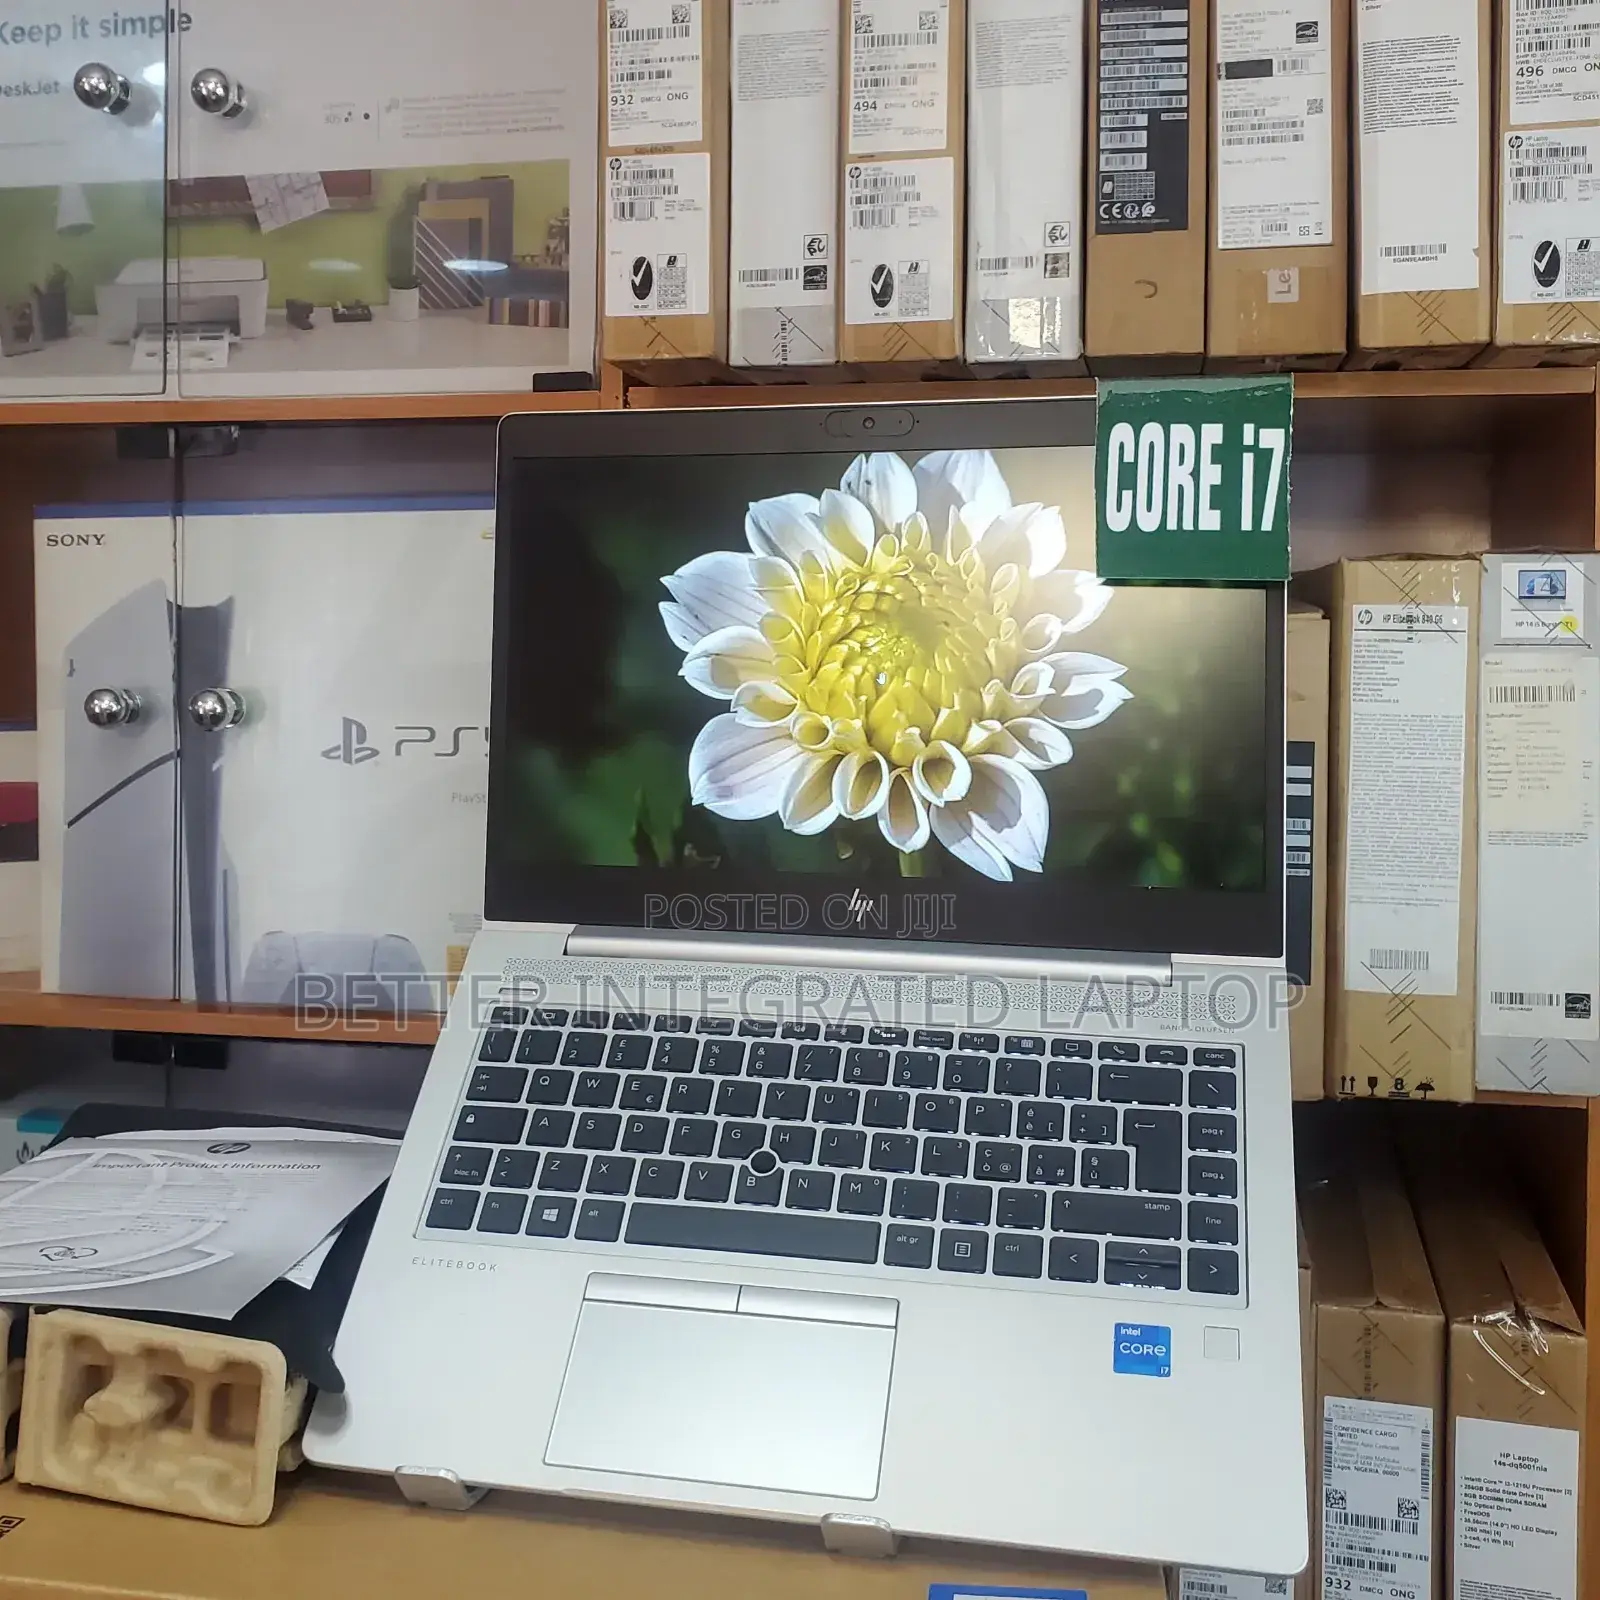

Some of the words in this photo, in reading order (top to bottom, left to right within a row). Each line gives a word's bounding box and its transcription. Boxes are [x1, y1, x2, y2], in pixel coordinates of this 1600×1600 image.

[72, 14, 90, 40] it
[99, 8, 193, 40] simple
[1516, 65, 1544, 78] 496
[1552, 66, 1577, 74] DMCQ
[0, 80, 60, 98] eskJet
[611, 94, 634, 106] 932
[667, 92, 689, 101] ONG
[853, 100, 878, 111] 494
[912, 99, 935, 108] ONG
[1105, 421, 1224, 532] CORE
[1240, 422, 1286, 532] i7
[46, 533, 106, 547] SONY
[1382, 614, 1392, 624] HP
[394, 726, 489, 757] PS
[664, 1042, 672, 1052] $
[568, 1050, 578, 1058] 2
[614, 1052, 622, 1062] 3
[660, 1054, 670, 1064] 4
[1205, 1052, 1225, 1060] canc
[708, 1058, 716, 1067] 5
[755, 1060, 763, 1070] 6
[804, 1064, 812, 1072] 7
[852, 1067, 860, 1076] 8
[902, 1070, 911, 1080] 9
[539, 1075, 550, 1086] Q
[586, 1078, 600, 1088] W
[630, 1081, 640, 1091] E
[678, 1084, 688, 1094] R
[726, 1087, 735, 1097] T
[776, 1090, 786, 1100] Y
[824, 1094, 834, 1104] U
[924, 1101, 936, 1112] O
[975, 1105, 985, 1116] P
[538, 1116, 550, 1127] A
[586, 1120, 595, 1130] S
[633, 1122, 644, 1133] D
[681, 1126, 690, 1136] F
[1202, 1128, 1217, 1136] pag
[731, 1129, 742, 1140] G
[780, 1132, 790, 1143] H
[830, 1136, 838, 1147] J
[881, 1140, 891, 1151] K
[932, 1145, 940, 1156] L
[92, 1160, 166, 1170] Important
[169, 1160, 228, 1170] Product
[230, 1161, 322, 1171] Information
[550, 1160, 560, 1171] Z
[598, 1163, 608, 1174] X
[1000, 1162, 1012, 1174] @
[648, 1166, 658, 1177] C
[698, 1170, 708, 1180] V
[1056, 1168, 1066, 1177] #
[1202, 1171, 1218, 1180] pag
[746, 1176, 756, 1186] B
[798, 1178, 808, 1189] N
[850, 1182, 862, 1193] M
[440, 1198, 453, 1206] ctrl
[1144, 1202, 1171, 1212] stamp
[1205, 1216, 1222, 1225] fine
[896, 1234, 908, 1243] alt
[909, 1236, 919, 1244] gr
[1004, 1244, 1020, 1252] ctrl
[411, 1256, 498, 1273] ELITEBOOK
[1333, 1424, 1373, 1435] CONFIDENCE
[1374, 1429, 1398, 1438] CARGO
[1512, 1454, 1540, 1464] Laptop
[1485, 1486, 1501, 1494] Solid
[1501, 1489, 1518, 1497] State
[1518, 1491, 1535, 1499] Drive
[1531, 1485, 1563, 1494] Processor
[1473, 1501, 1495, 1510] Optical
[1496, 1504, 1512, 1512] Drive
[1478, 1494, 1504, 1503] SODIMM
[1523, 1500, 1547, 1509] SDRAM
[1463, 1508, 1491, 1517] FreeDOS
[1535, 1527, 1558, 1536] Display
[1463, 1542, 1481, 1550] Silver
[1325, 1576, 1352, 1591] 932
[1359, 1585, 1384, 1595] DMCQ
[1389, 1588, 1416, 1600] ONG
